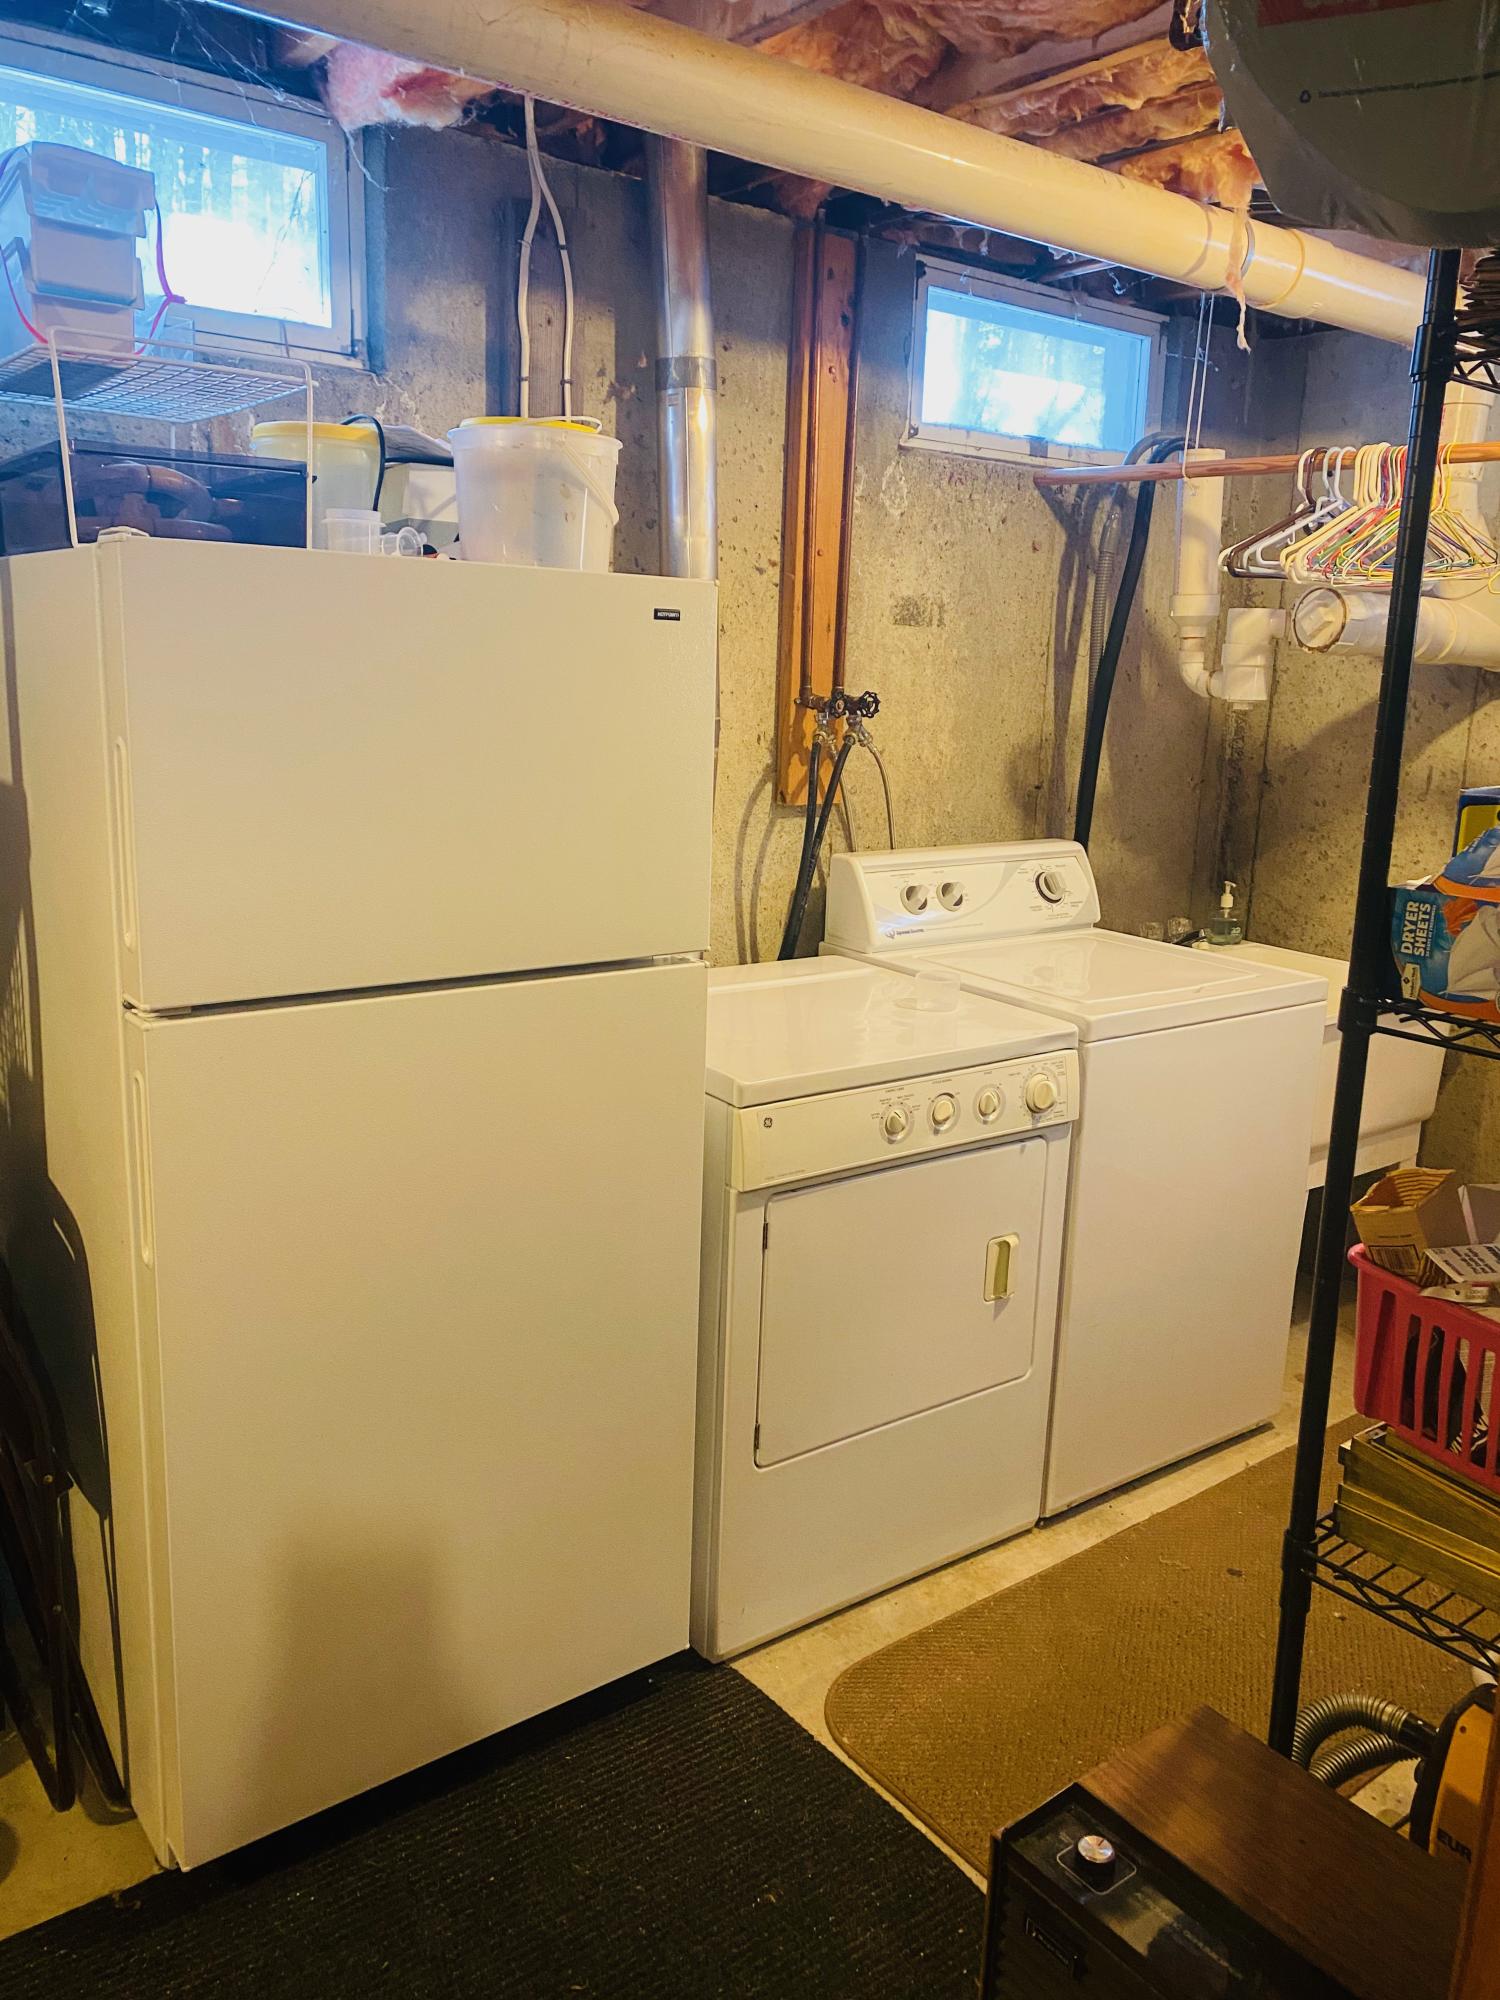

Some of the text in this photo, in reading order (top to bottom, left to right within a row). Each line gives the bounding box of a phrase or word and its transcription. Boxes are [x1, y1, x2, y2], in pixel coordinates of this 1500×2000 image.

[1401, 901, 1419, 954] DRYER
[1413, 903, 1431, 956] SHEETS
[1437, 1827, 1472, 1864] EUR
